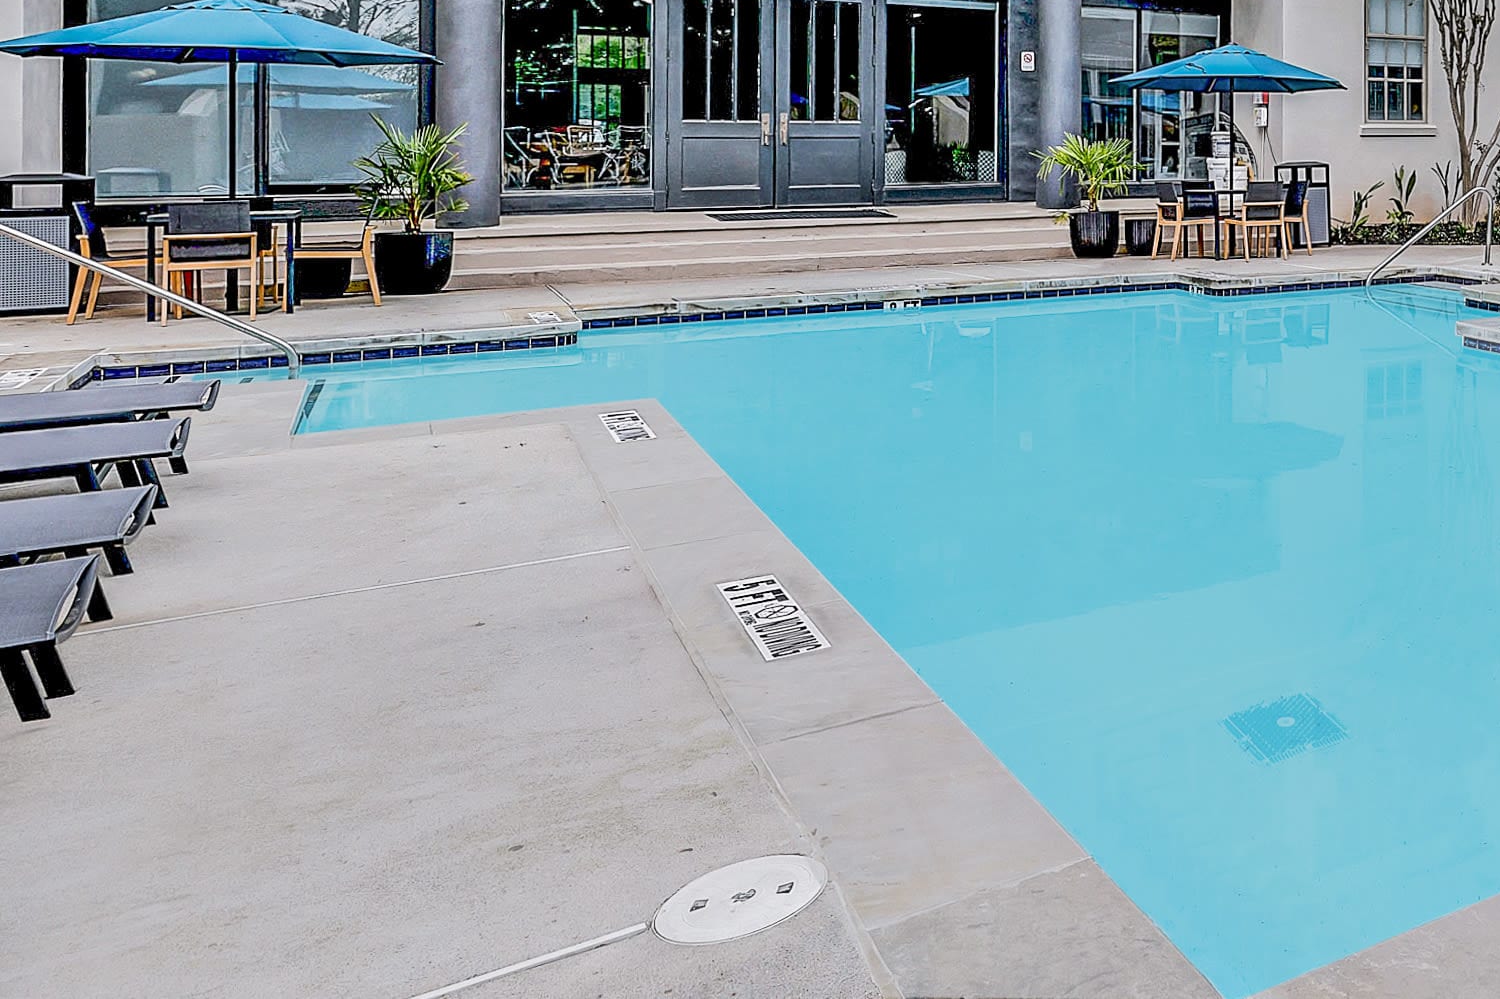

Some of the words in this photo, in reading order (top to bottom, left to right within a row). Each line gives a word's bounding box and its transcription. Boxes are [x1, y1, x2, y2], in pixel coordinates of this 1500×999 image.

[723, 579, 777, 591] 5
[729, 588, 789, 608] FT
[759, 625, 822, 658] DIVING
